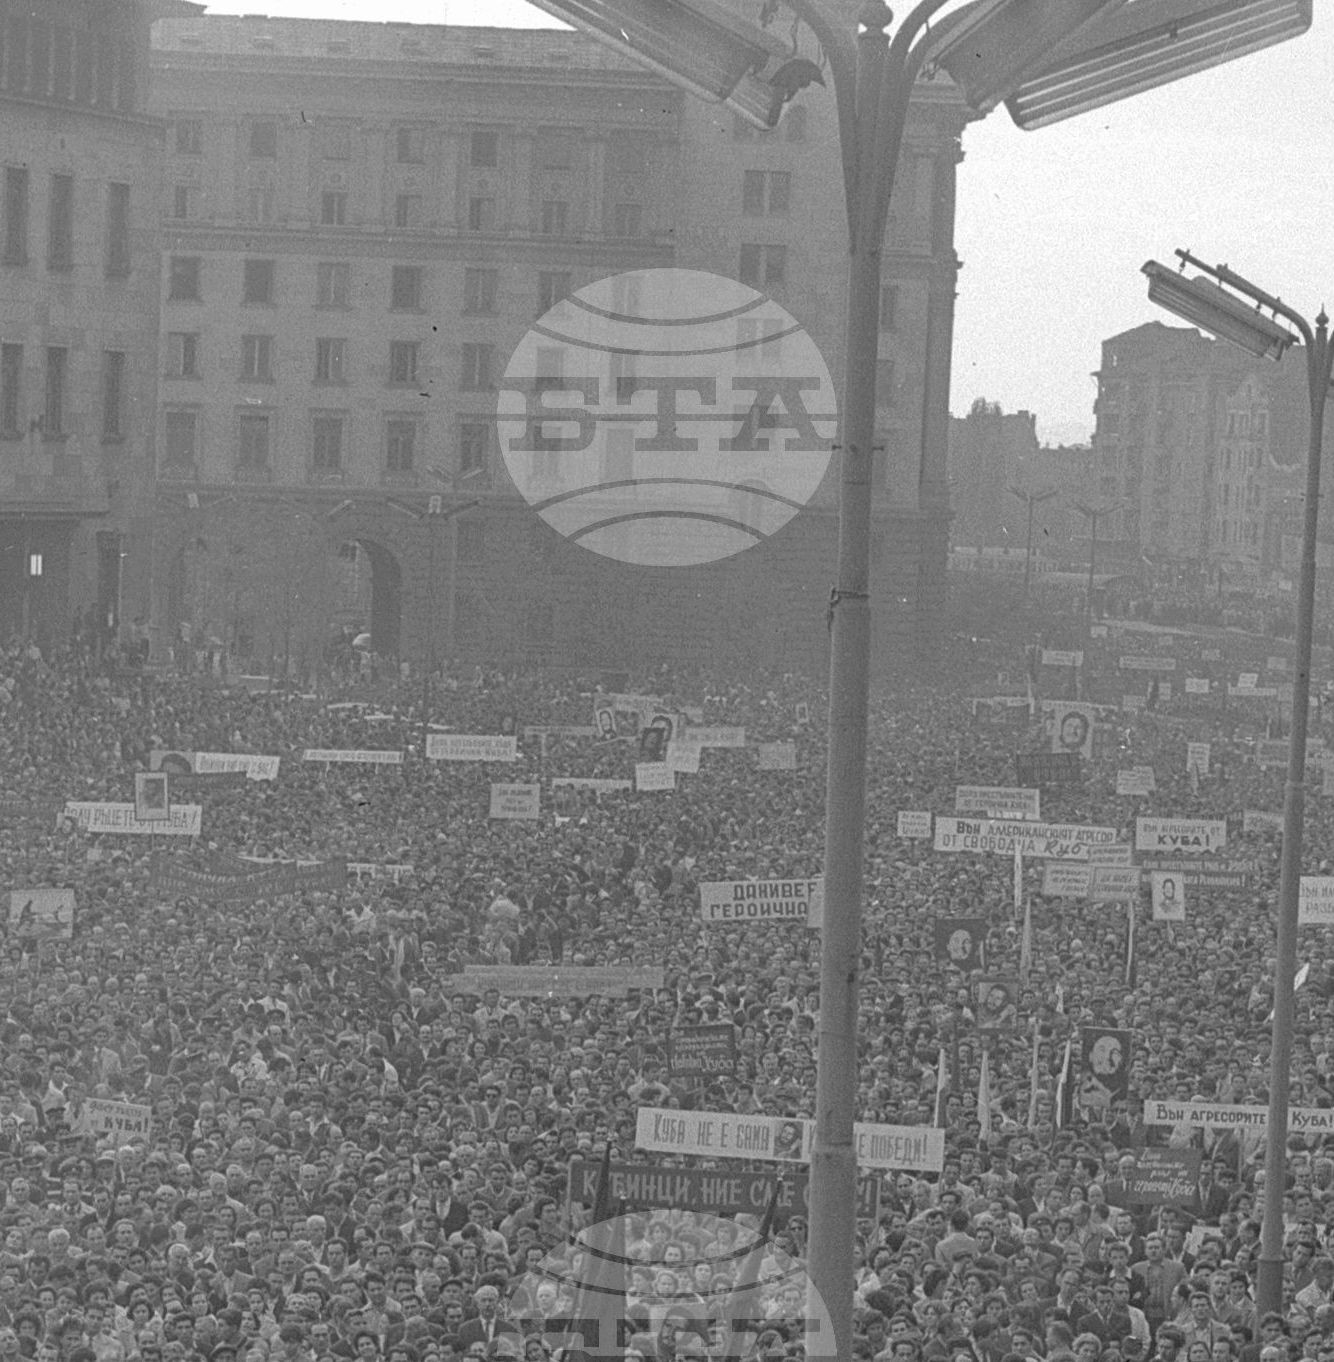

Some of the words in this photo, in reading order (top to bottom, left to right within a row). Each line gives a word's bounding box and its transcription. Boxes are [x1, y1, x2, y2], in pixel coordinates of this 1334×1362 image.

[956, 821, 980, 835] ВЪН
[942, 834, 957, 847] ОТ
[1158, 834, 1210, 846] КУБА!
[710, 901, 808, 918] ГЕРОИЧНА
[104, 1116, 149, 1133] КУБА!
[1156, 1104, 1184, 1121] ВЪН
[1191, 1110, 1267, 1124] АГРЕСОРИТЕ
[1292, 1111, 1333, 1128] КУБА!
[654, 1113, 686, 1144] КУБА
[696, 1120, 713, 1146] НЕ
[720, 1121, 729, 1148] Е
[736, 1121, 770, 1152] САМА
[870, 1133, 928, 1165] ПОБЕДИ!
[583, 1170, 696, 1205] КБИНЦИ,
[703, 1178, 743, 1206] НИЕ
